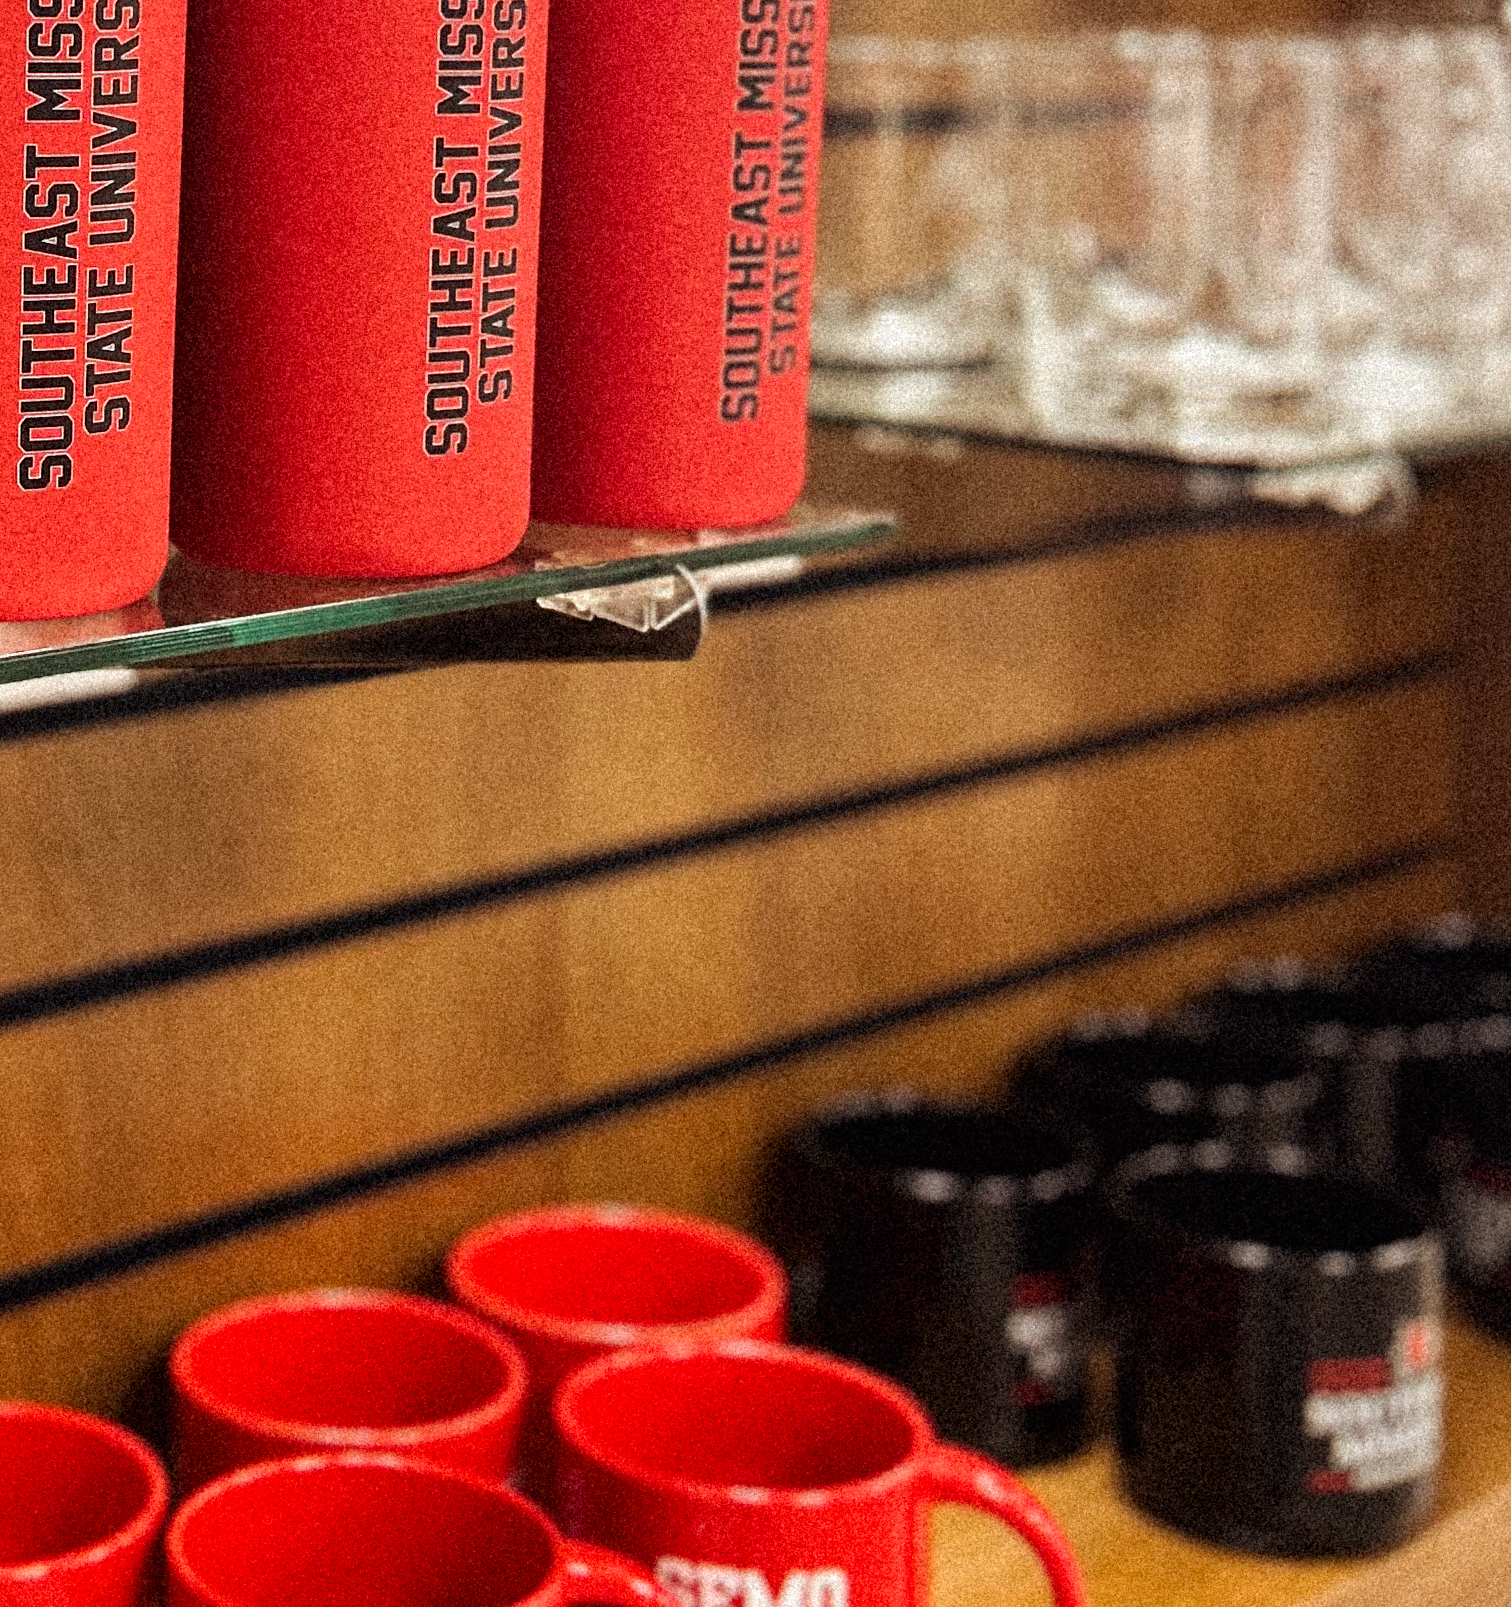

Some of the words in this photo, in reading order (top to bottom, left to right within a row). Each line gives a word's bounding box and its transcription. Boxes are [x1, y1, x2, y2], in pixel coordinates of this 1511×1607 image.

[16, 142, 82, 493] SOUTHEAST
[81, 263, 136, 437] STATE
[422, 135, 481, 458] SOUTHEAST
[476, 247, 519, 405] STATE
[719, 131, 773, 423] SOUTHEAST
[767, 241, 802, 379] STATE
